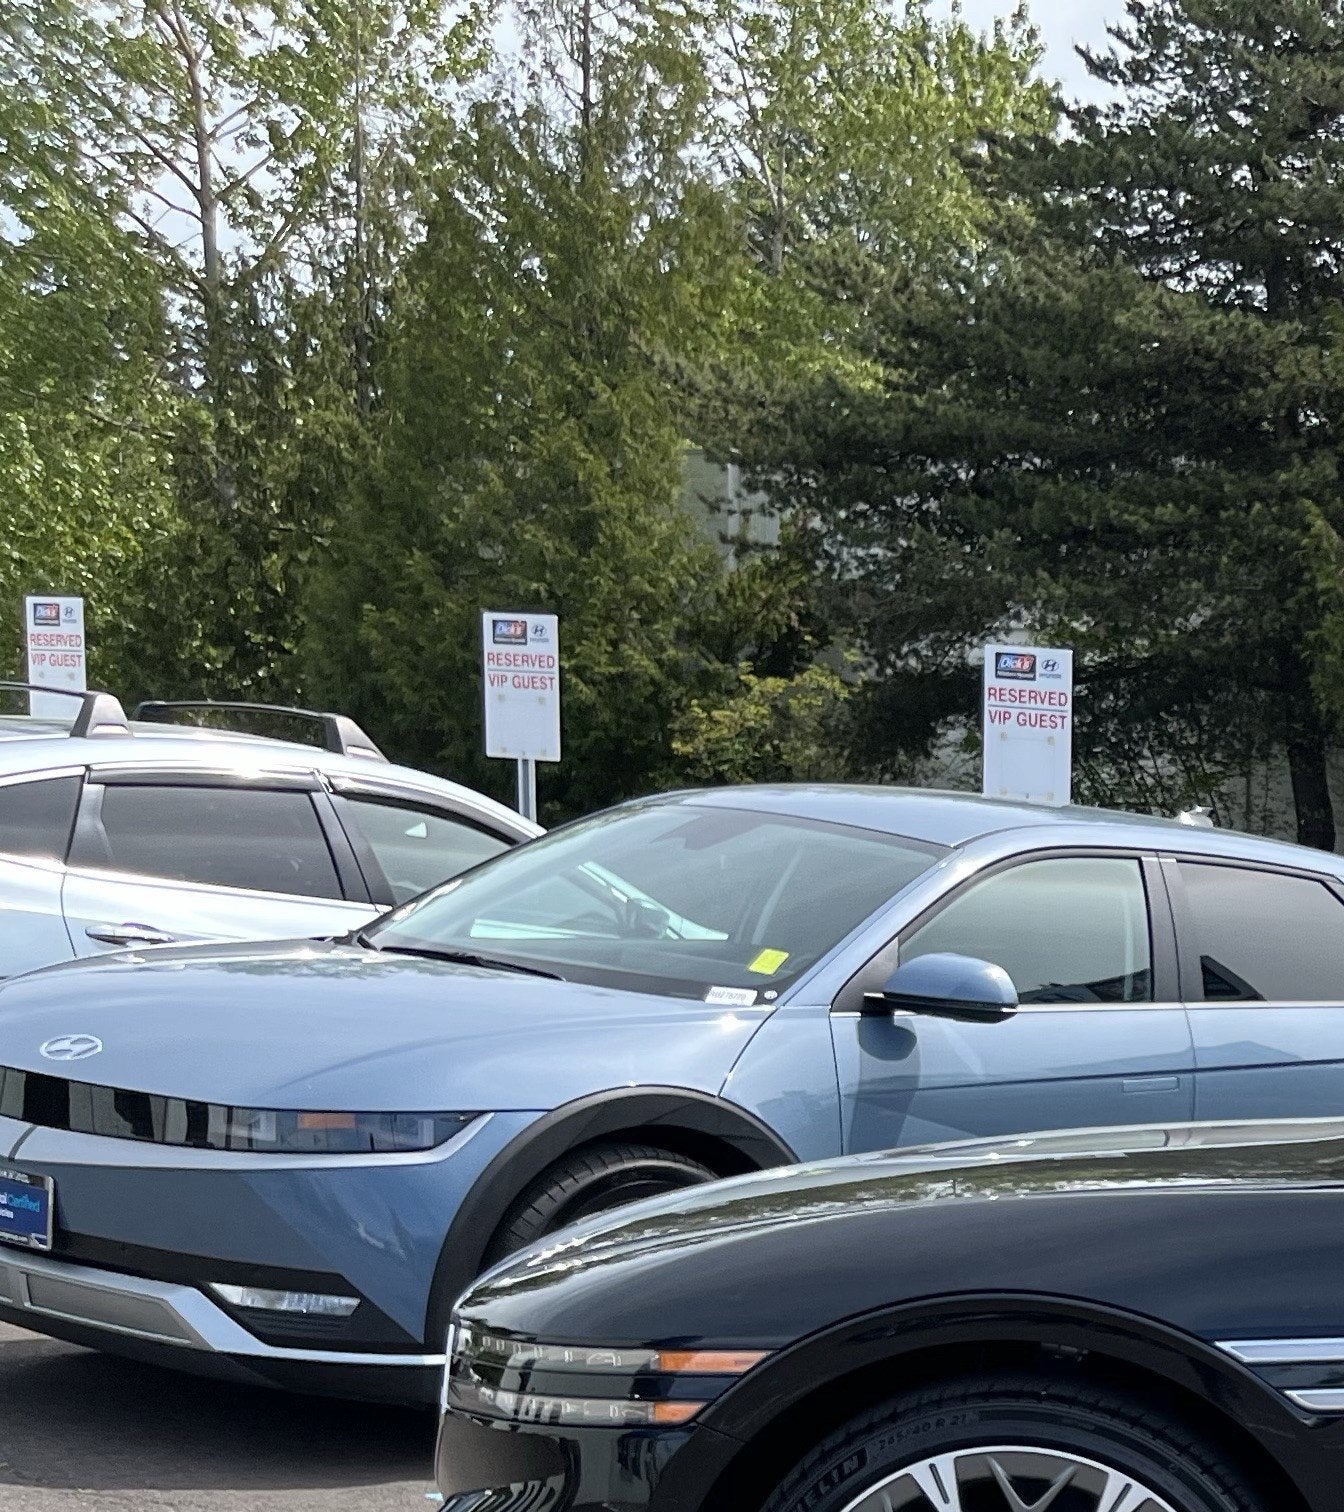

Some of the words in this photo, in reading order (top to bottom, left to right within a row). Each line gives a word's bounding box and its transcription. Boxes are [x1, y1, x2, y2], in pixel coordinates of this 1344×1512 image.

[29, 633, 82, 648] RESERVED
[30, 653, 47, 666] VIP
[49, 653, 82, 668] GUEST
[487, 652, 555, 669] RESERVED
[488, 673, 508, 688] VIP
[512, 674, 556, 691] GUEST
[987, 686, 1069, 708] RESERVED
[988, 709, 1012, 725] VIP
[1016, 711, 1068, 730] GUEST
